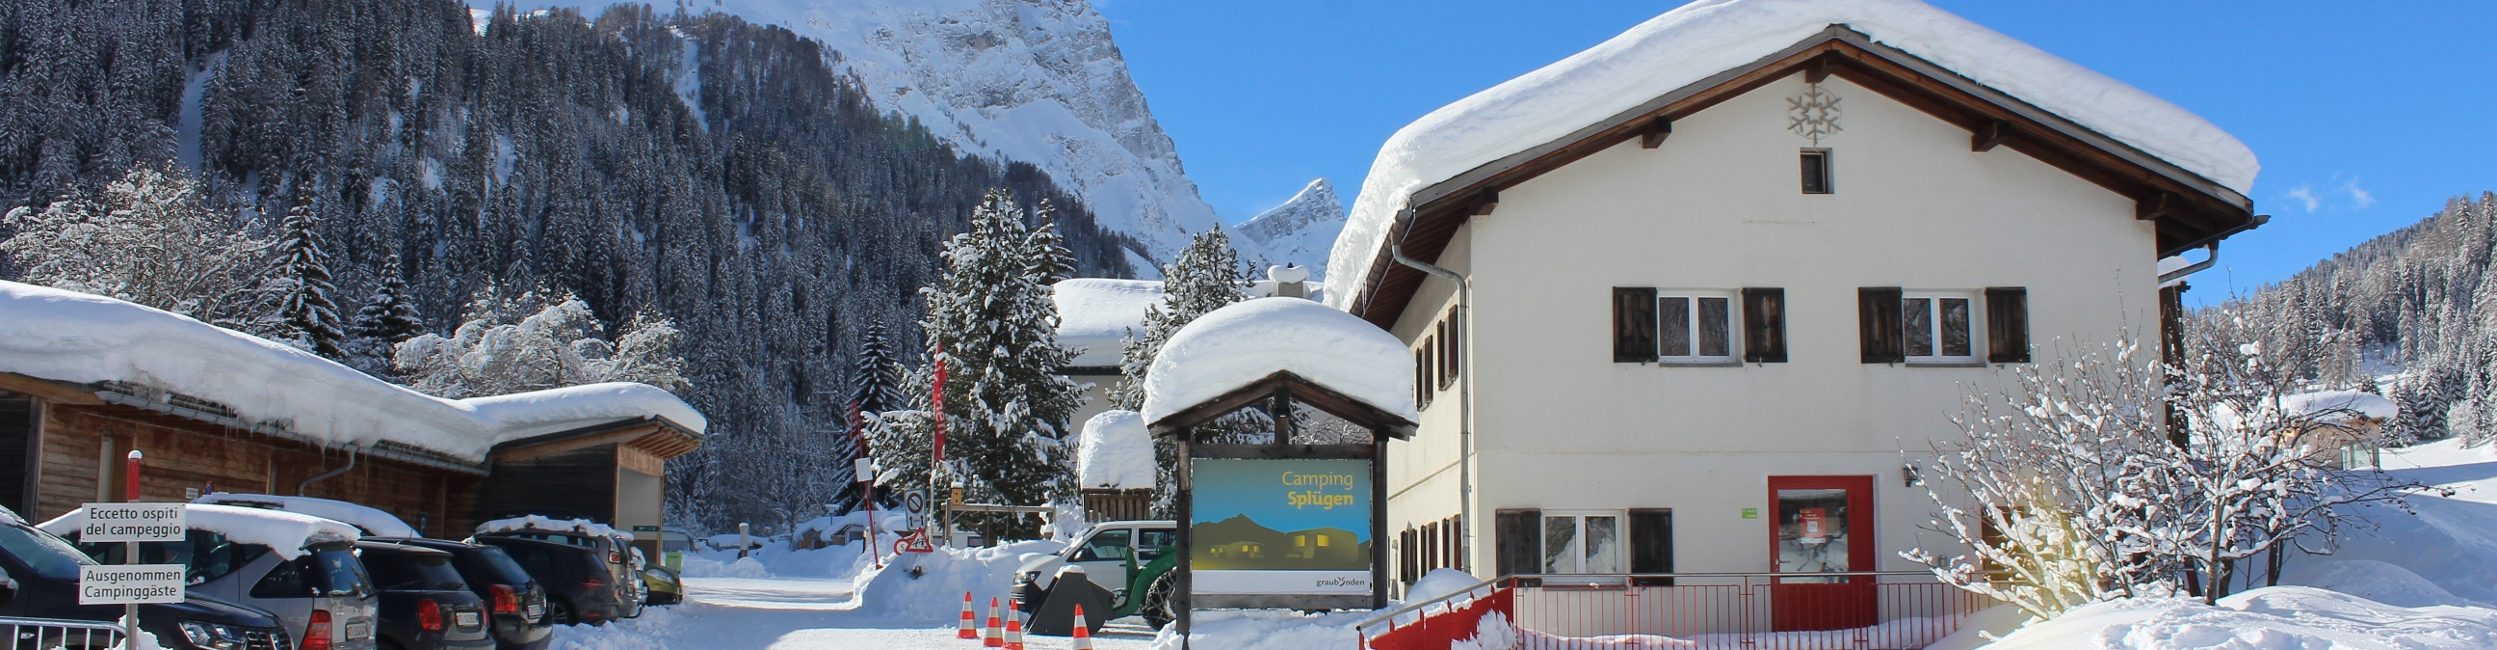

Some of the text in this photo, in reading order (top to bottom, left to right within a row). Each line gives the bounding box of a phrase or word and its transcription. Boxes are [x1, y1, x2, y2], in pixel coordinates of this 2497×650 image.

[1282, 470, 1353, 490] Camping
[1287, 490, 1354, 510] Splügen
[90, 506, 178, 521] Eccetto ospiti
[86, 523, 181, 538] del campeggio
[85, 570, 181, 584] Ausgenommen
[84, 585, 177, 600] Campinggäste
